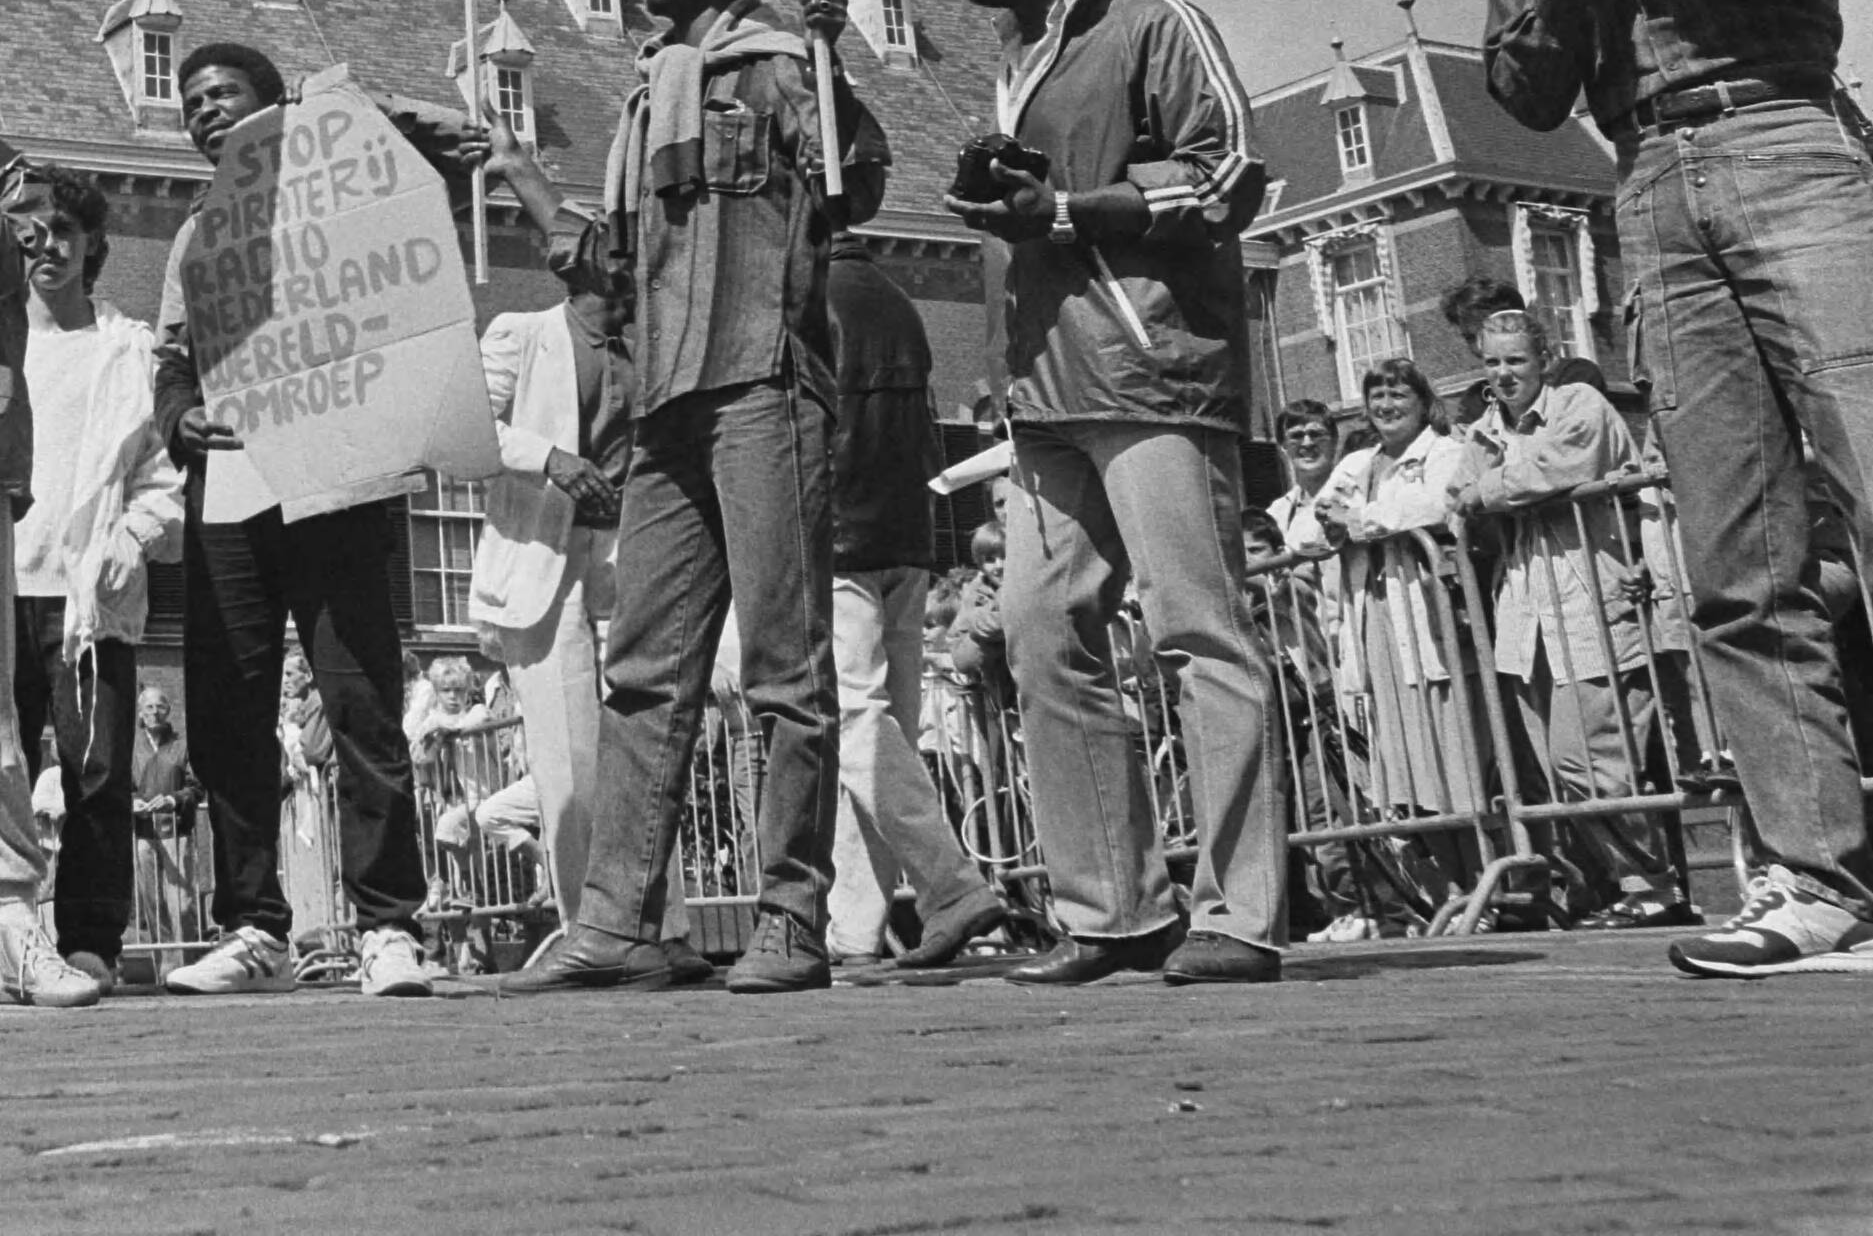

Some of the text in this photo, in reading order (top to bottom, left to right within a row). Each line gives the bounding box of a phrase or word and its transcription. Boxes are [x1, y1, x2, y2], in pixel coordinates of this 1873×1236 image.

[233, 109, 354, 189] STOP
[184, 220, 331, 302] RADIO
[191, 236, 442, 344] NEDERLAND
[211, 351, 385, 434] OMROEP
